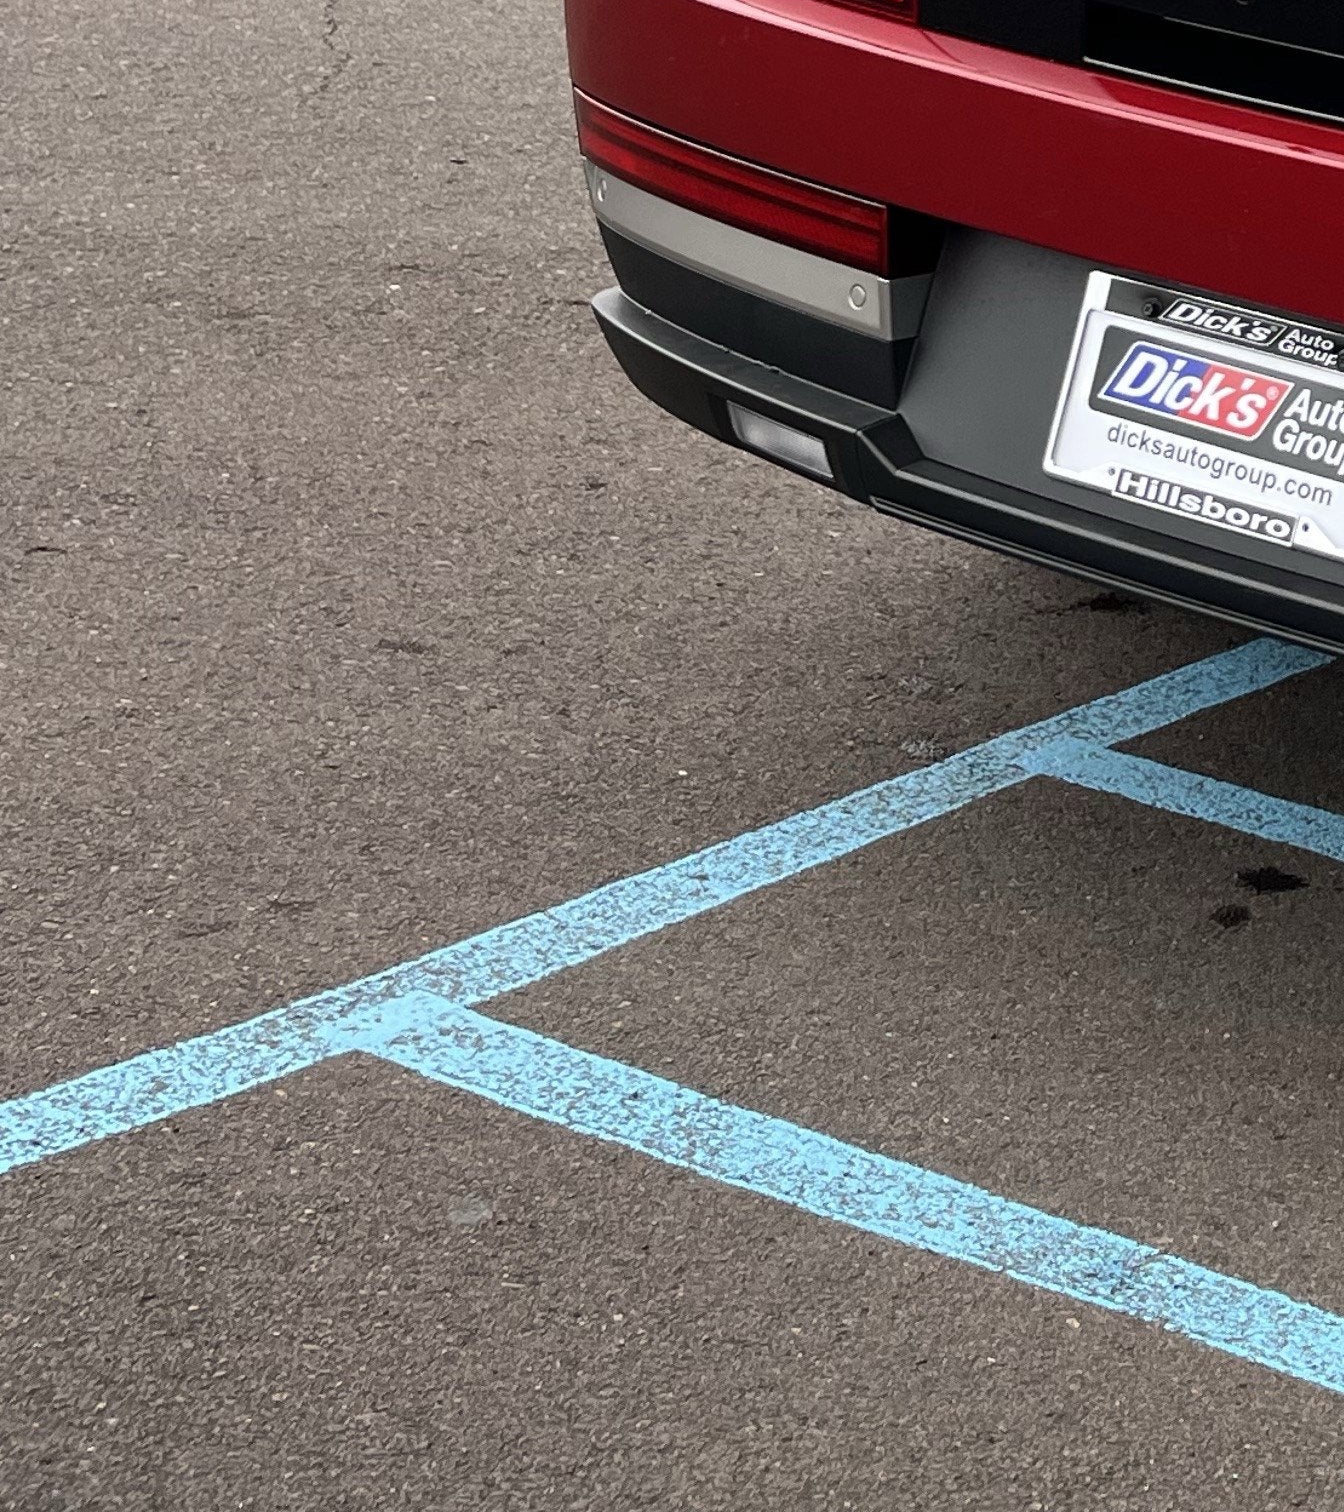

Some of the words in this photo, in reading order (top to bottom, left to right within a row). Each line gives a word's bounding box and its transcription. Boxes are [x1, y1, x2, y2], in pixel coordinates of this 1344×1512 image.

[1171, 302, 1272, 343] Dick's
[1286, 328, 1335, 351] Auto
[1117, 352, 1269, 426] Dick's
[1107, 424, 1334, 506] dicksautogroup.com
[1118, 468, 1292, 539] Hillsboro
